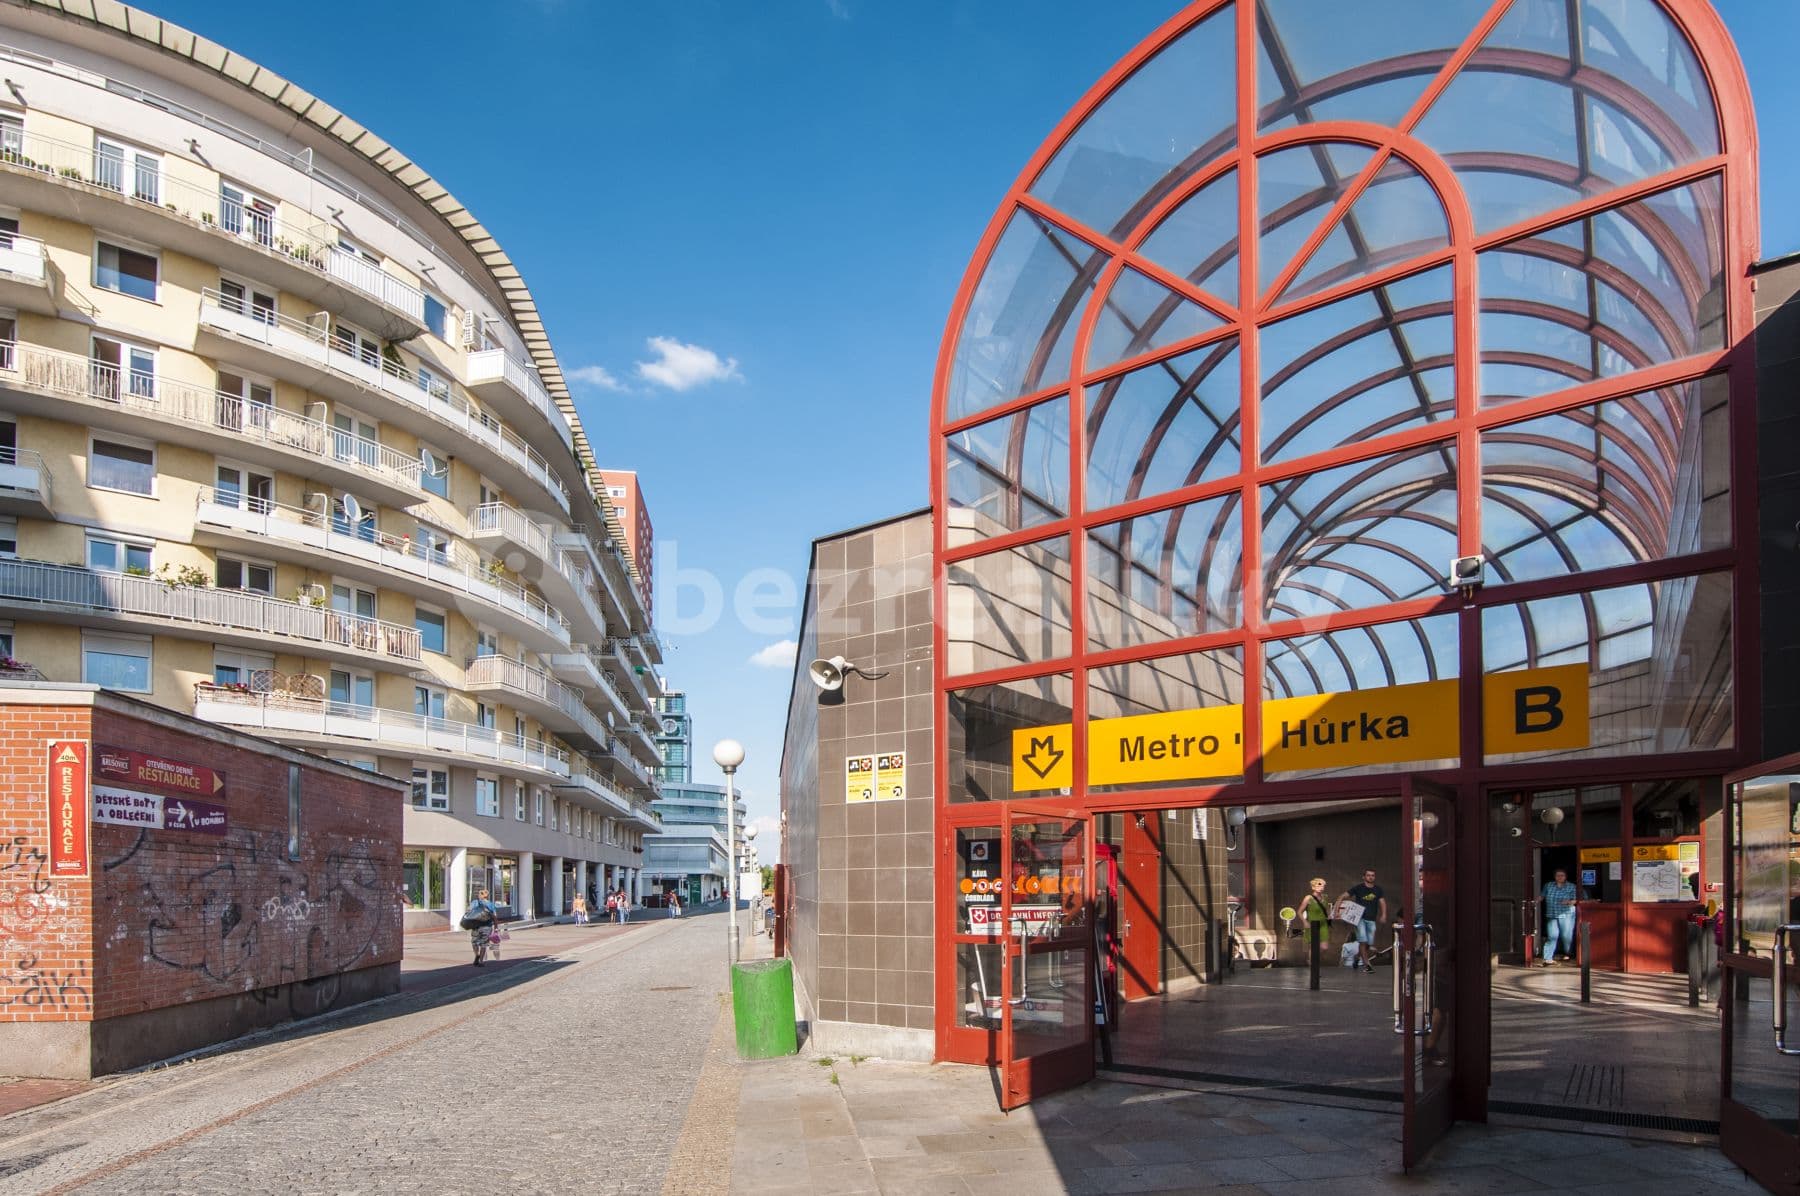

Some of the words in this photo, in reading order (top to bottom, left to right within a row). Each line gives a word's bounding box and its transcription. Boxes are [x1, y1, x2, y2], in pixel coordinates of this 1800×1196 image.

[1119, 732, 1219, 762] Metro
[1281, 712, 1409, 748] Hůrka
[1515, 685, 1564, 735] B
[146, 759, 175, 772] OTEVŘENO
[175, 766, 193, 776] DENNÍ
[138, 766, 201, 789] RESTAURACE
[95, 793, 132, 806] DĚTSKÉ
[62, 766, 73, 854] RESTAURACE
[97, 809, 104, 818] A
[109, 809, 155, 823] OBLEČENÍ
[990, 910, 1031, 920] DOAVNÍ
